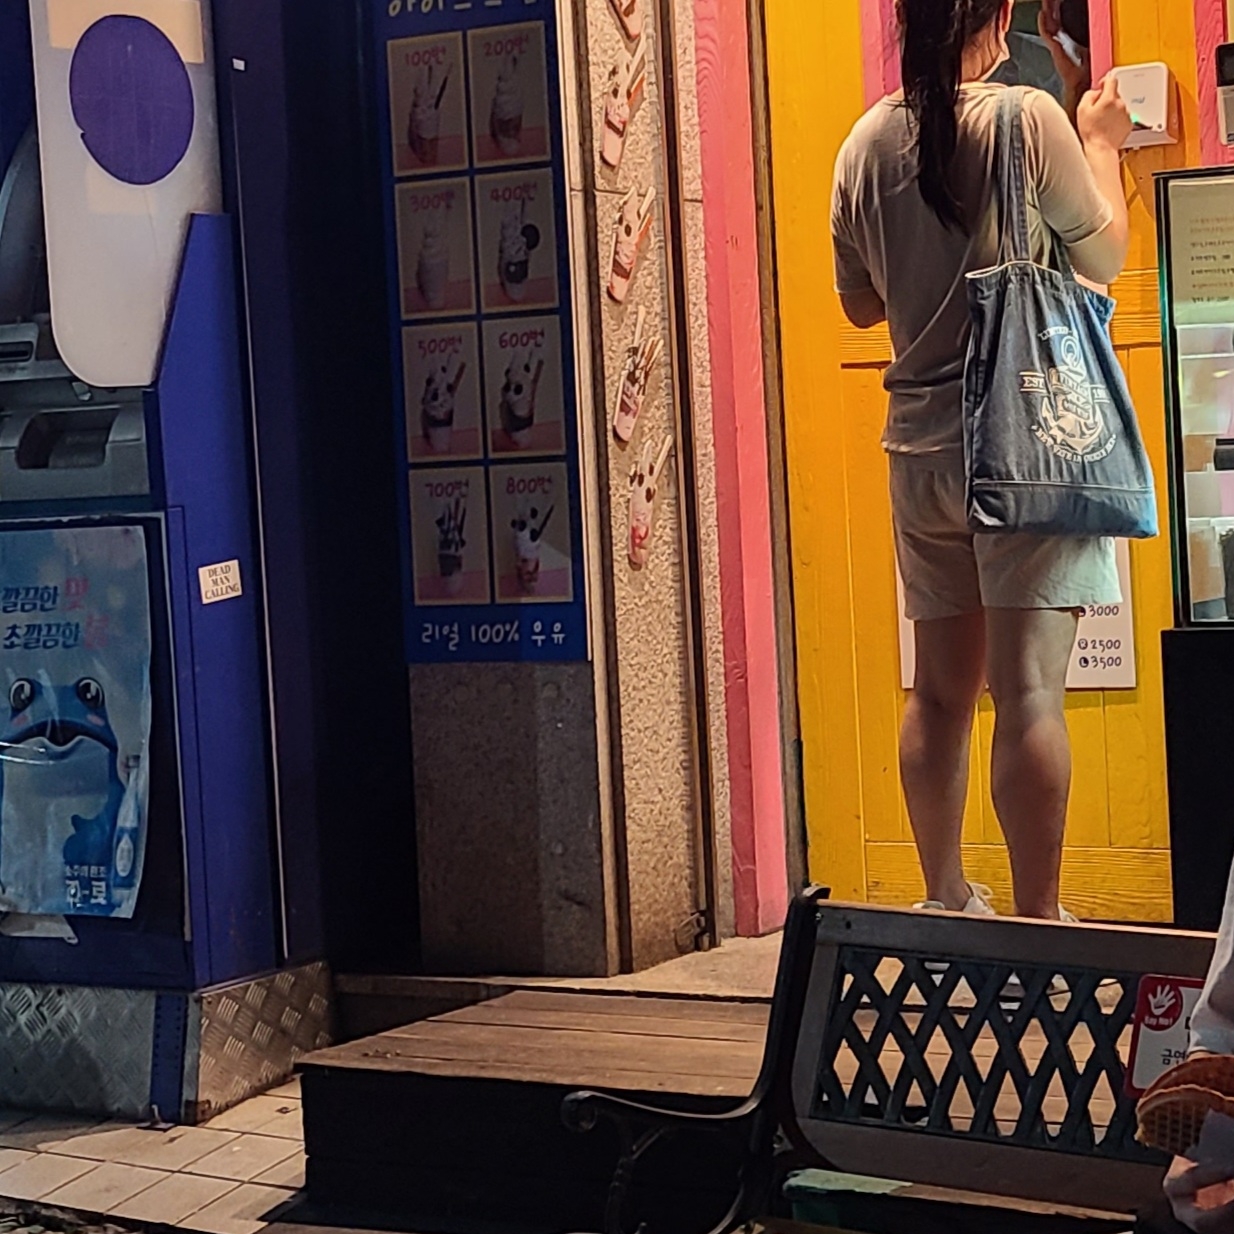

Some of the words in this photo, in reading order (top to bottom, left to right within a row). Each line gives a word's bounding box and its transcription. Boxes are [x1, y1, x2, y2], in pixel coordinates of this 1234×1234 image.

[208, 564, 231, 578] DEAD
[212, 576, 230, 587] MAN
[204, 582, 240, 600] CALLING
[1088, 605, 1120, 617] 3000
[3, 622, 81, 650] 초깔끔한
[422, 622, 460, 650] 리얼
[470, 620, 520, 644] 100%
[531, 621, 566, 647] 우유
[1090, 639, 1121, 653] 2500
[1090, 656, 1122, 670] 3500
